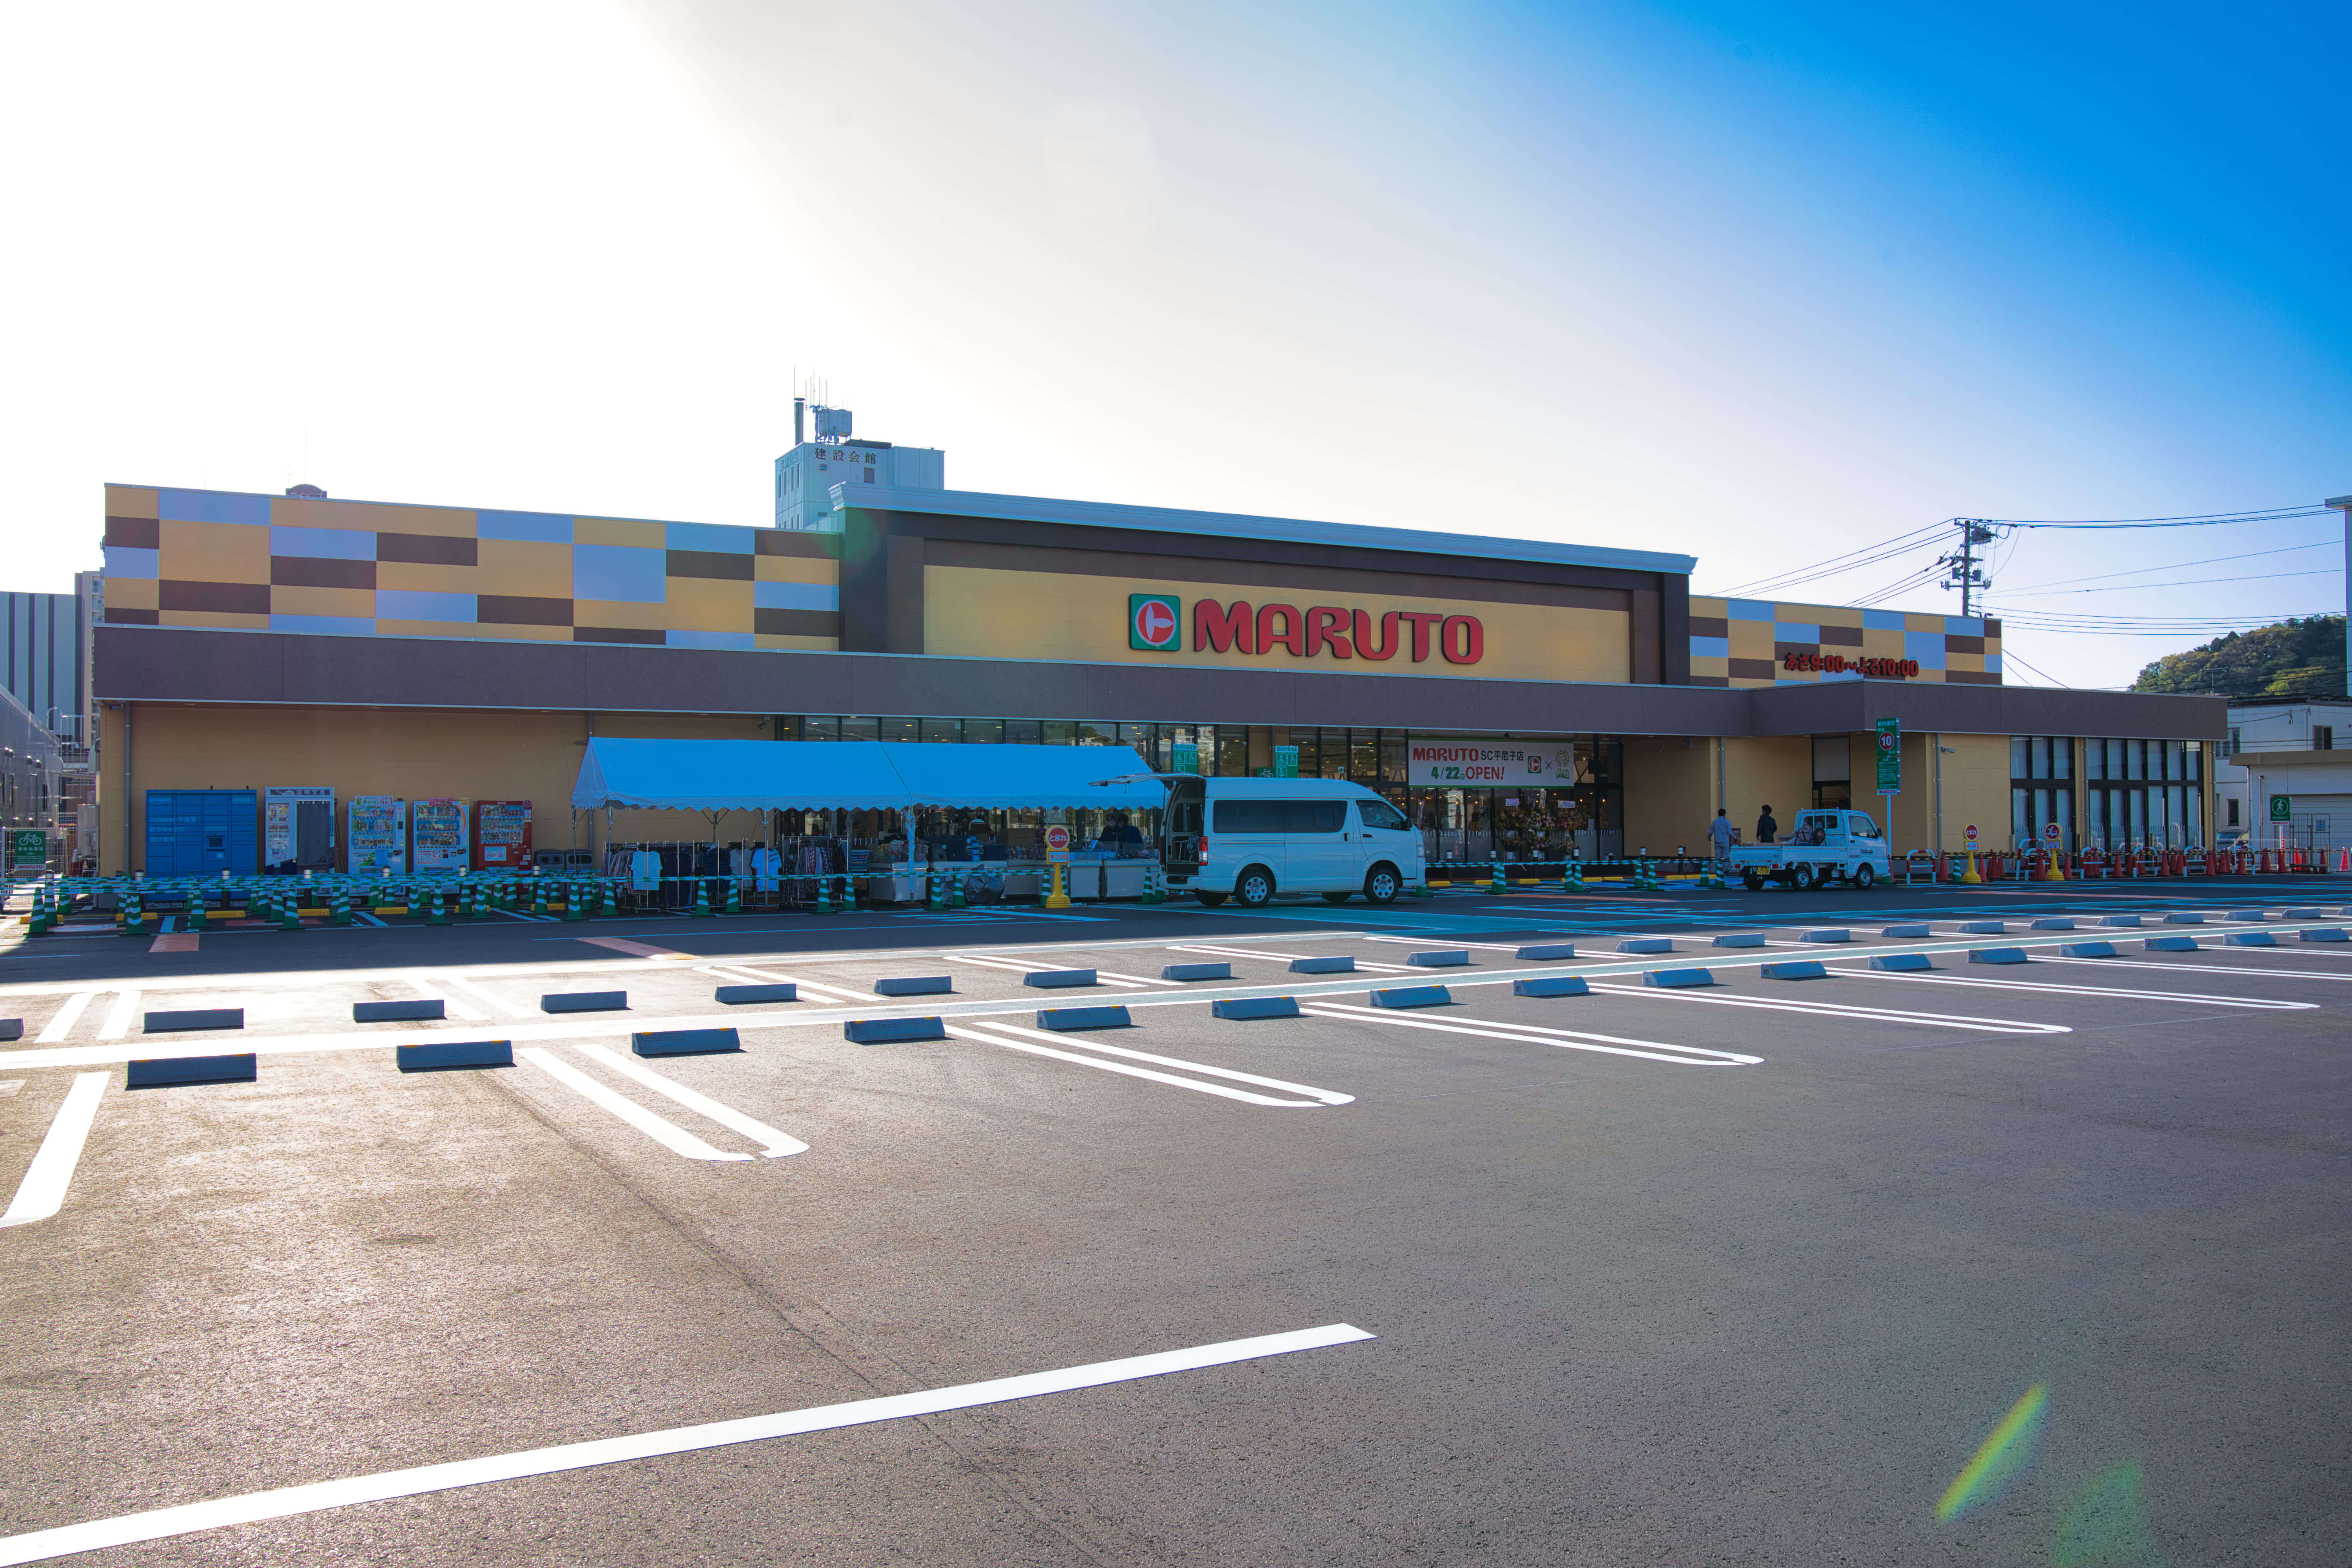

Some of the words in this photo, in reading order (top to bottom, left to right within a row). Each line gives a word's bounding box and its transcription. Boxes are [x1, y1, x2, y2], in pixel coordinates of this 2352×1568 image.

[814, 448, 877, 465] 建設会館
[1194, 599, 1484, 664] MARUTO
[1881, 736, 1892, 746] 10
[1413, 748, 1479, 761] MARUTO
[1481, 750, 1524, 761] SC平尼子店
[1431, 766, 1459, 779] 4/22
[1465, 766, 1505, 780] OPEN!
